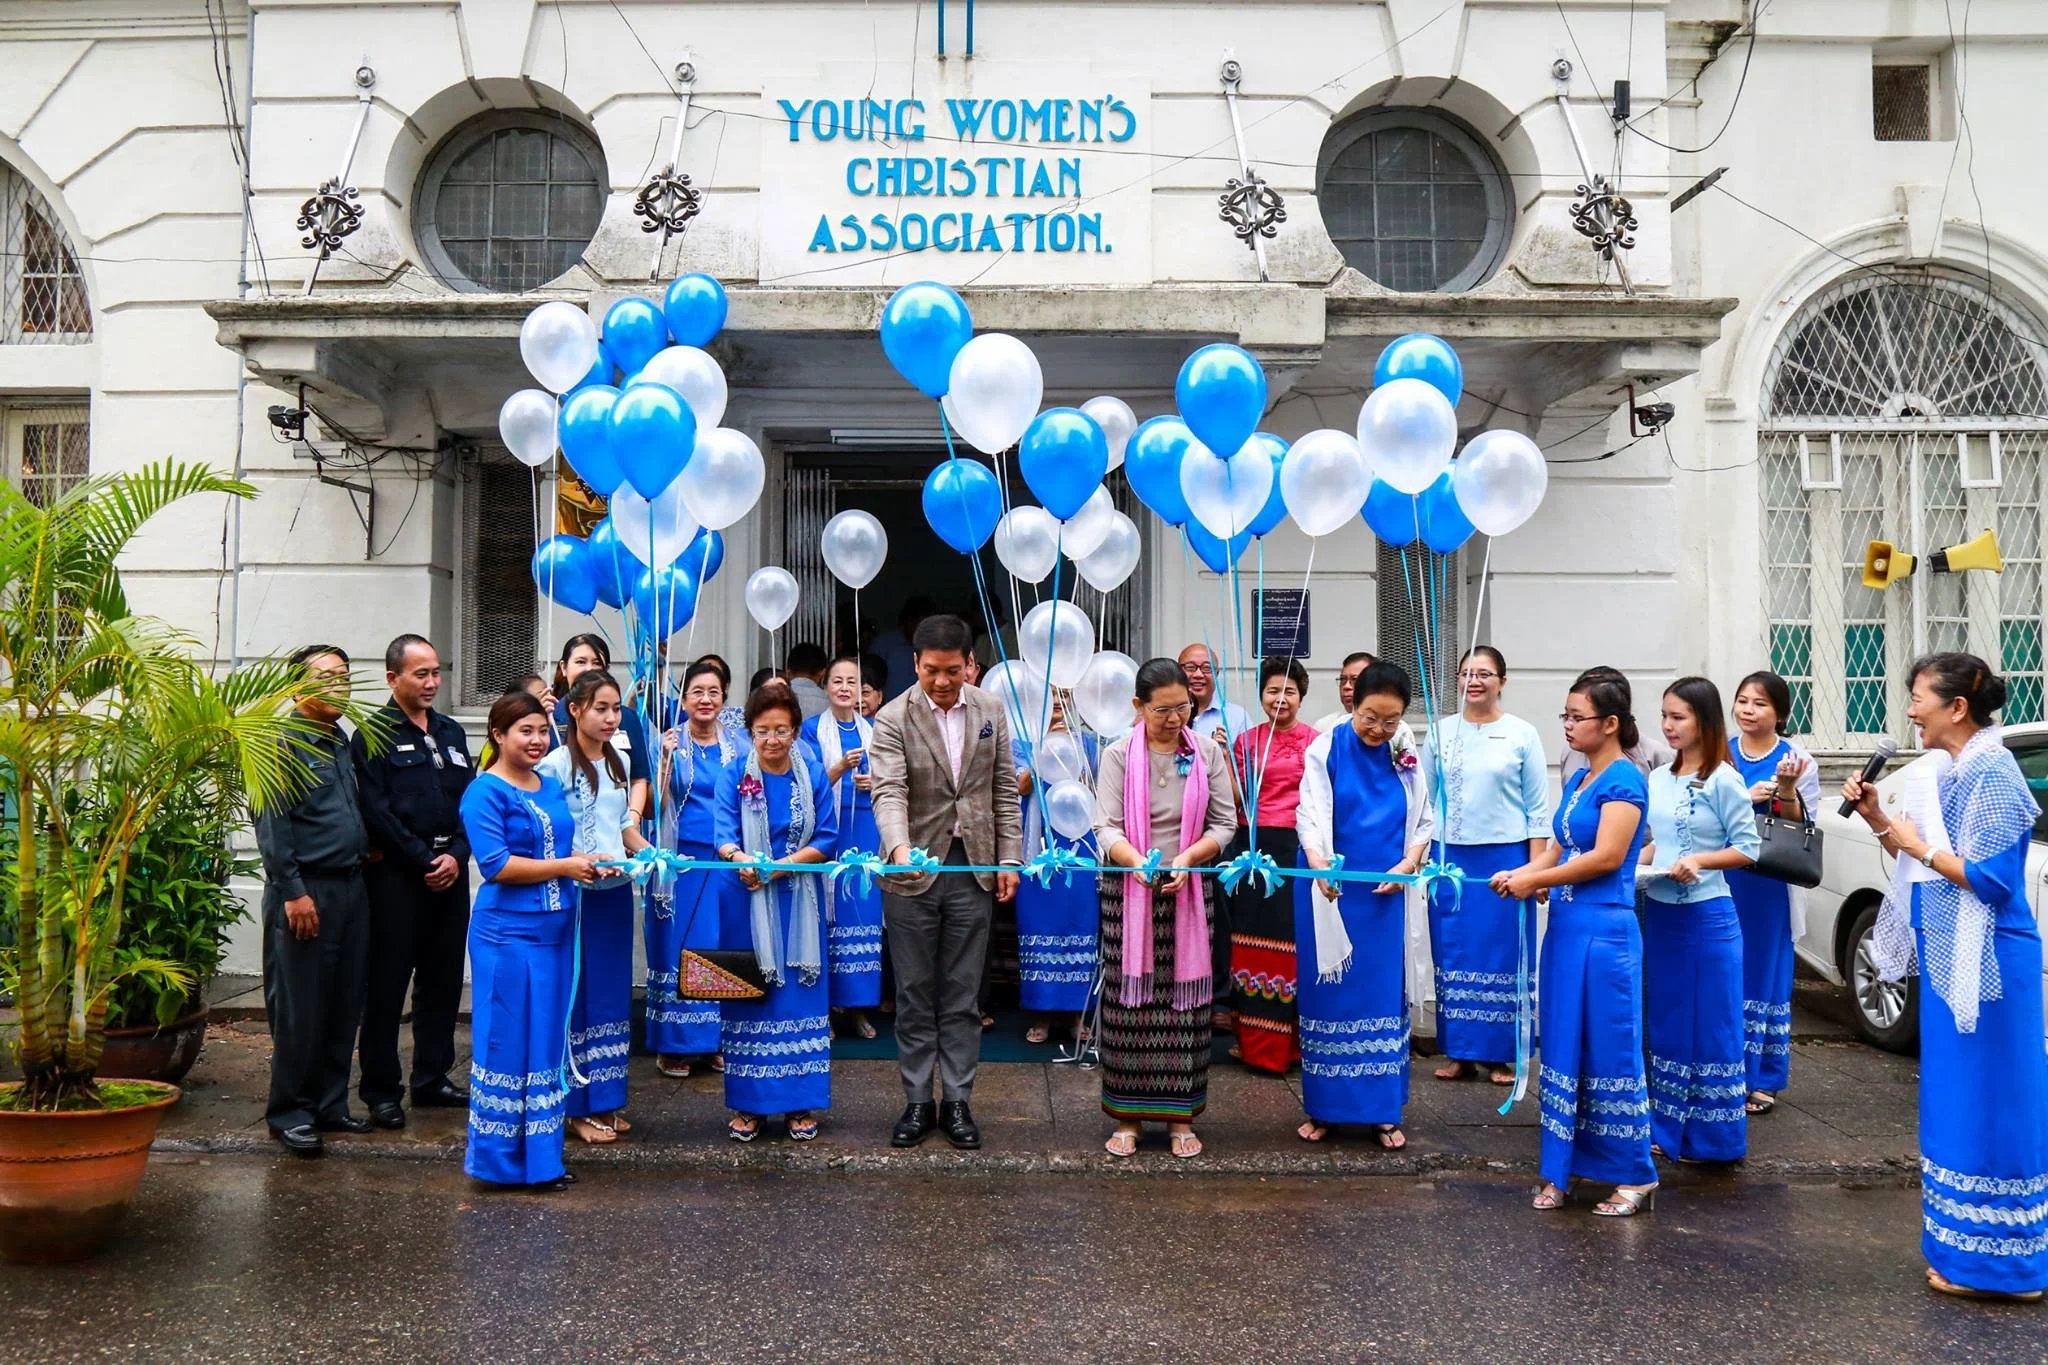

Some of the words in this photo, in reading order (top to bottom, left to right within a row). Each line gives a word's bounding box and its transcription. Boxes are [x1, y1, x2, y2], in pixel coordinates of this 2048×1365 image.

[777, 98, 927, 142] YOUNG
[945, 93, 1138, 143] WOMEN'S
[845, 156, 1082, 198] CHRISTIAN
[807, 211, 1113, 253] ASSOCIATION.
